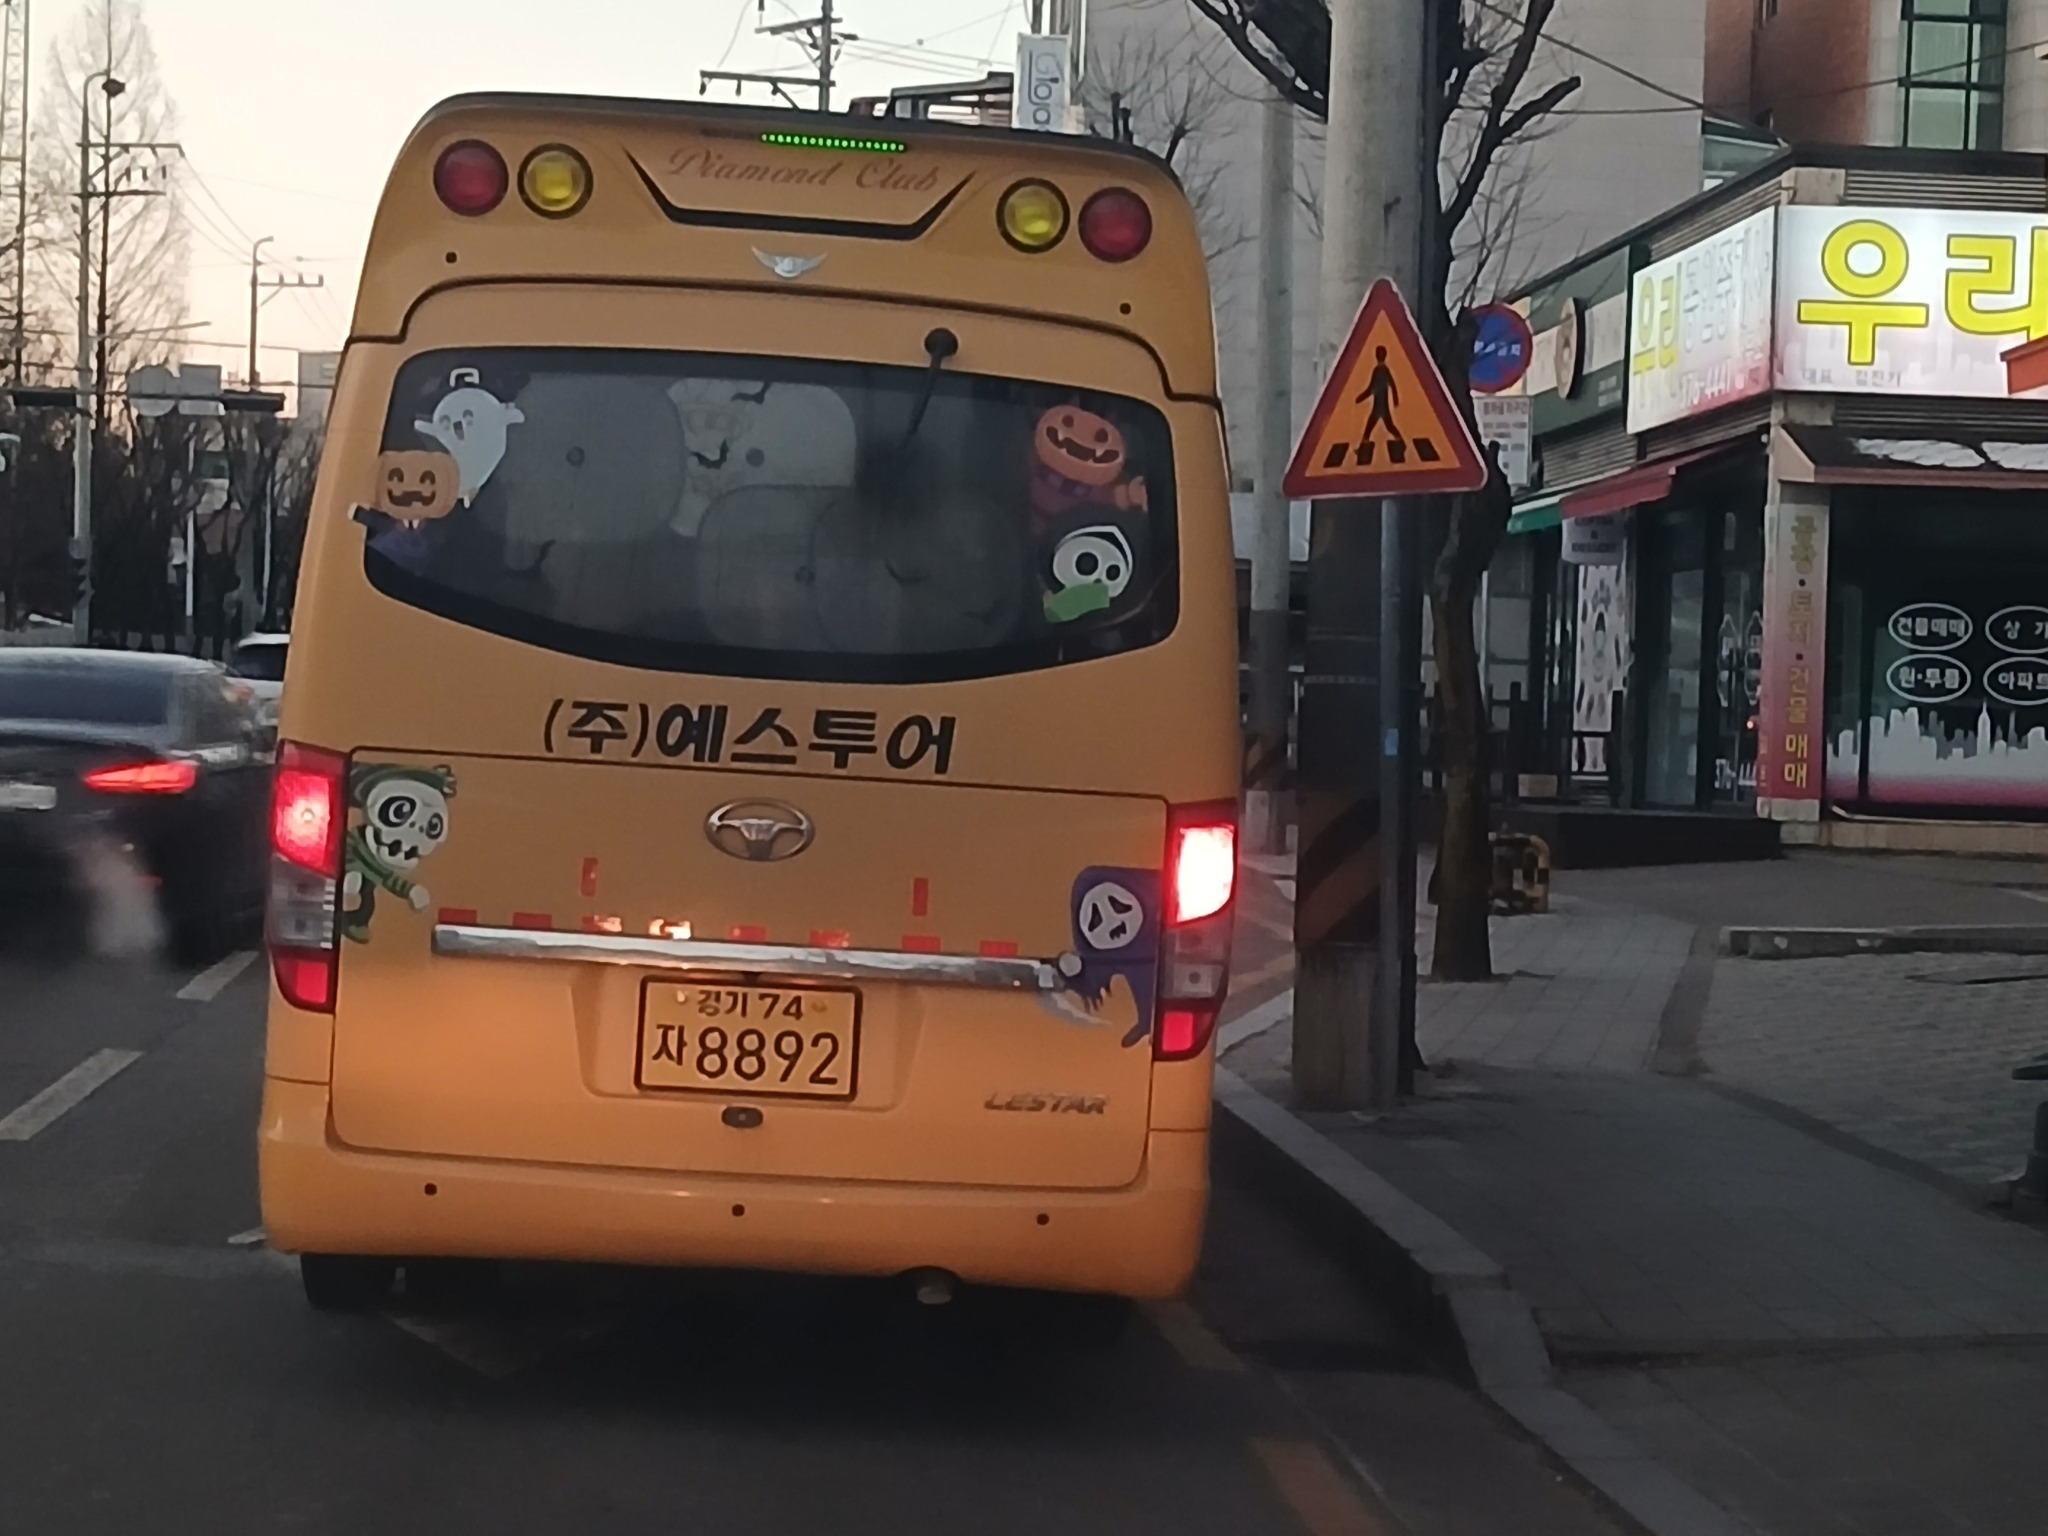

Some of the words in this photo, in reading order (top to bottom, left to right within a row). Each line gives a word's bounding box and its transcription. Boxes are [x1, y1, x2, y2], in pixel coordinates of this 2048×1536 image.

[669, 148, 843, 186] Diamond
[855, 157, 940, 191] Club
[697, 989, 749, 1018] 경기
[758, 993, 804, 1021] 74
[984, 1092, 1109, 1115] LESTAR
